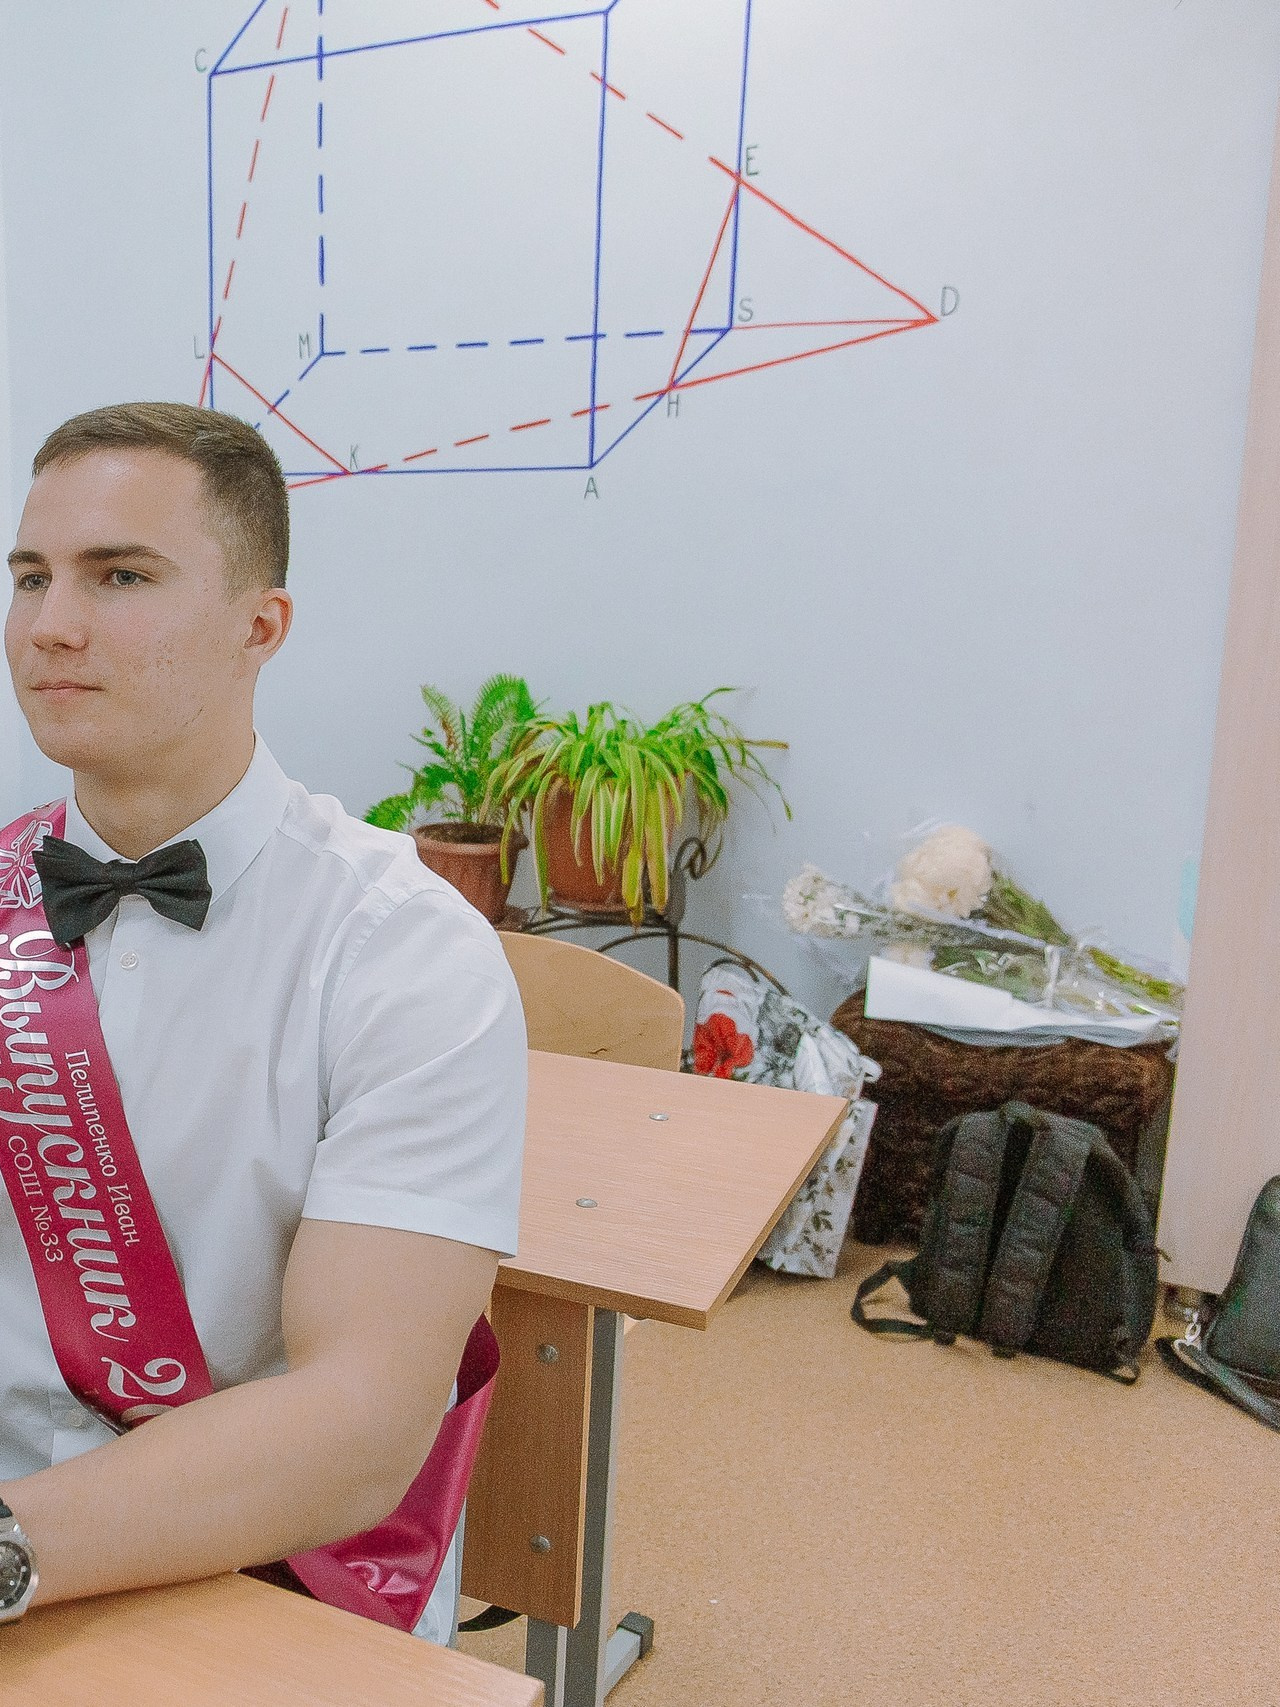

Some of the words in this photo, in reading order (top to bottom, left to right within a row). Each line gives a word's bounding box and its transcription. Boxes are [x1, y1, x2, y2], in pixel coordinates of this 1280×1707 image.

[194, 48, 208, 73] C
[745, 144, 759, 176] E
[737, 298, 754, 323] S
[940, 286, 960, 317] D
[193, 334, 205, 360] L
[297, 332, 311, 360] M
[666, 393, 680, 418] H
[349, 444, 359, 470] K
[583, 476, 600, 500] A
[64, 1048, 117, 1177] Пелипенко
[106, 1182, 140, 1247] Иван
[7, 1135, 44, 1197] СОШ
[28, 1204, 64, 1263] №33
[100, 1356, 187, 1422] 2
